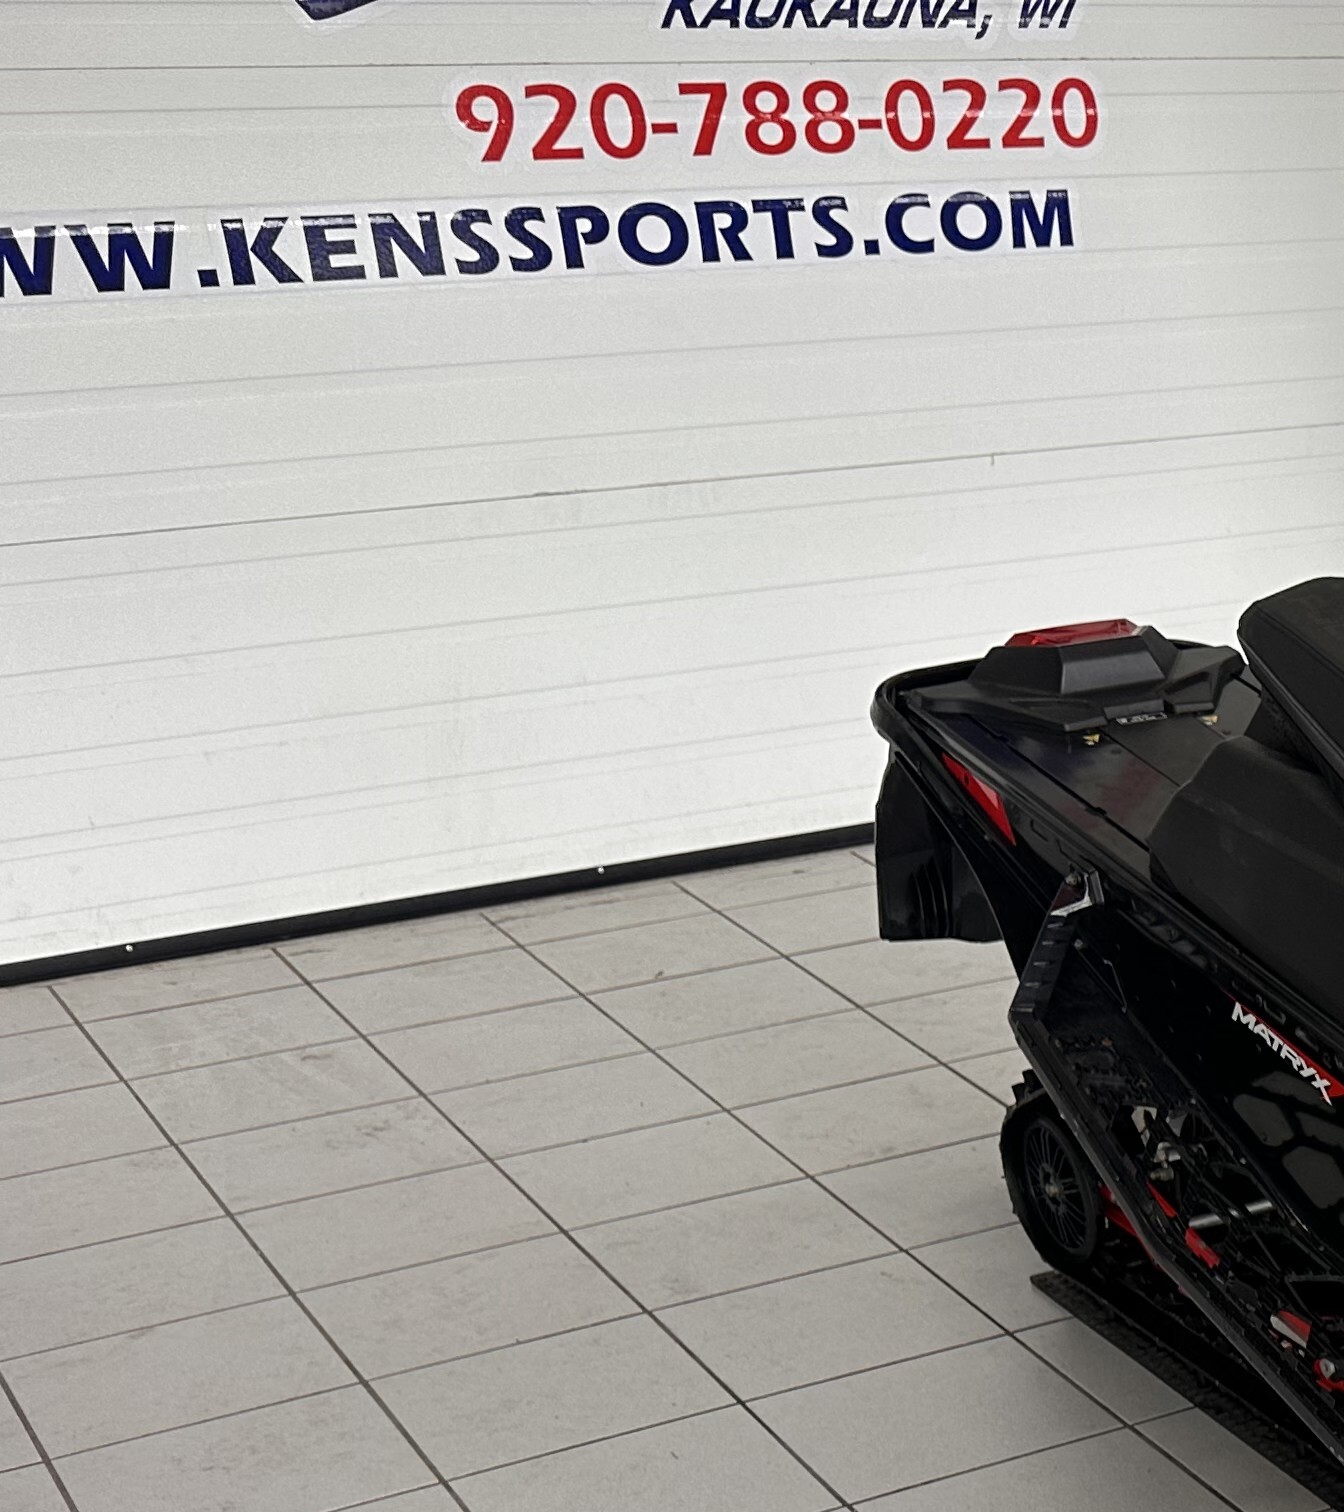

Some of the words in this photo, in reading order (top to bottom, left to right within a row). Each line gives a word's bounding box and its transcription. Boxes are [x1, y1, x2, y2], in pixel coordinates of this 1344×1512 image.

[1018, 0, 1076, 29] WI
[455, 77, 1099, 162] 920-788-0220
[1231, 1001, 1333, 1106] MATRYX
